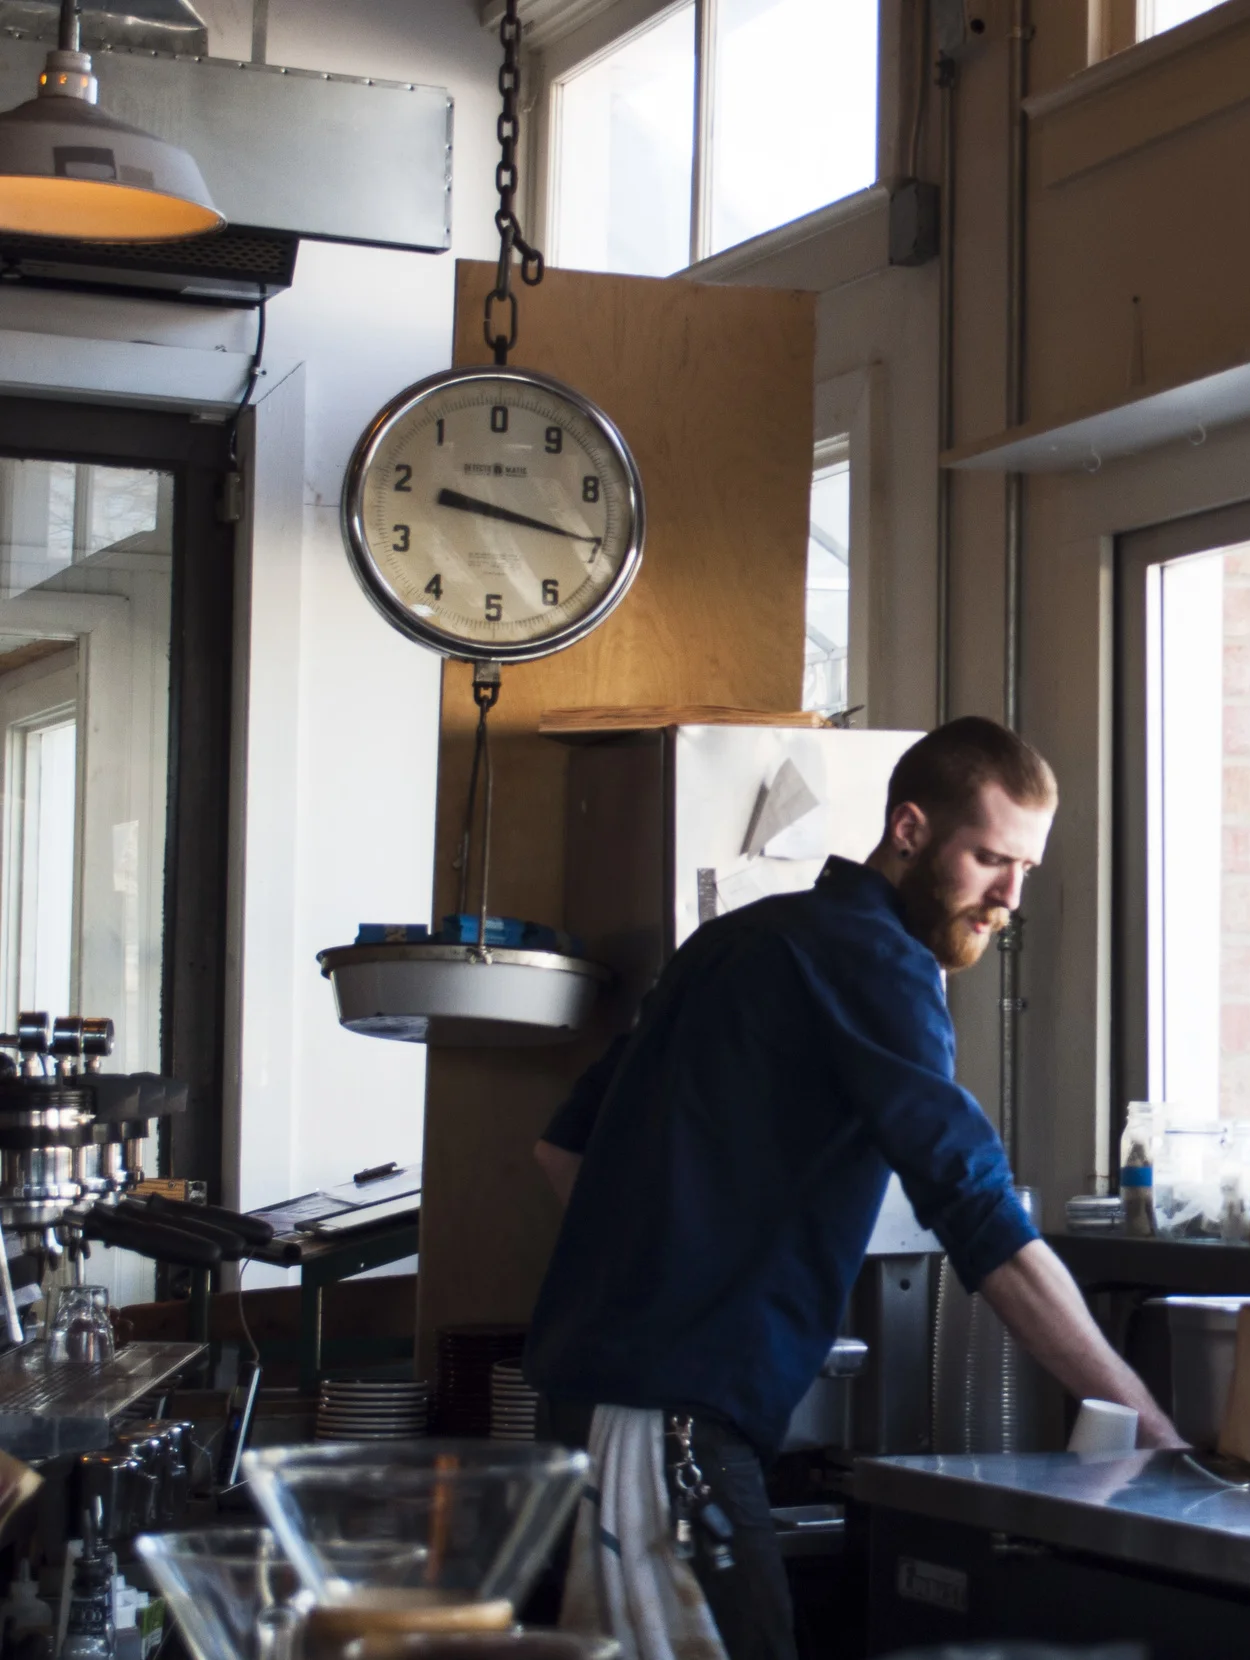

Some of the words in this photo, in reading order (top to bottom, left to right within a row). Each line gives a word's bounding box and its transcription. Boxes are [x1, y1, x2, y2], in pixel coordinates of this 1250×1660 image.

[436, 418, 445, 446] 1
[490, 405, 508, 434] 0
[544, 426, 563, 454] 9
[394, 464, 413, 492] 2
[582, 475, 599, 503] 8
[392, 524, 410, 552] 3
[585, 537, 602, 563] 7
[424, 573, 443, 600] 4
[541, 578, 559, 606] 6
[485, 593, 503, 622] 5
